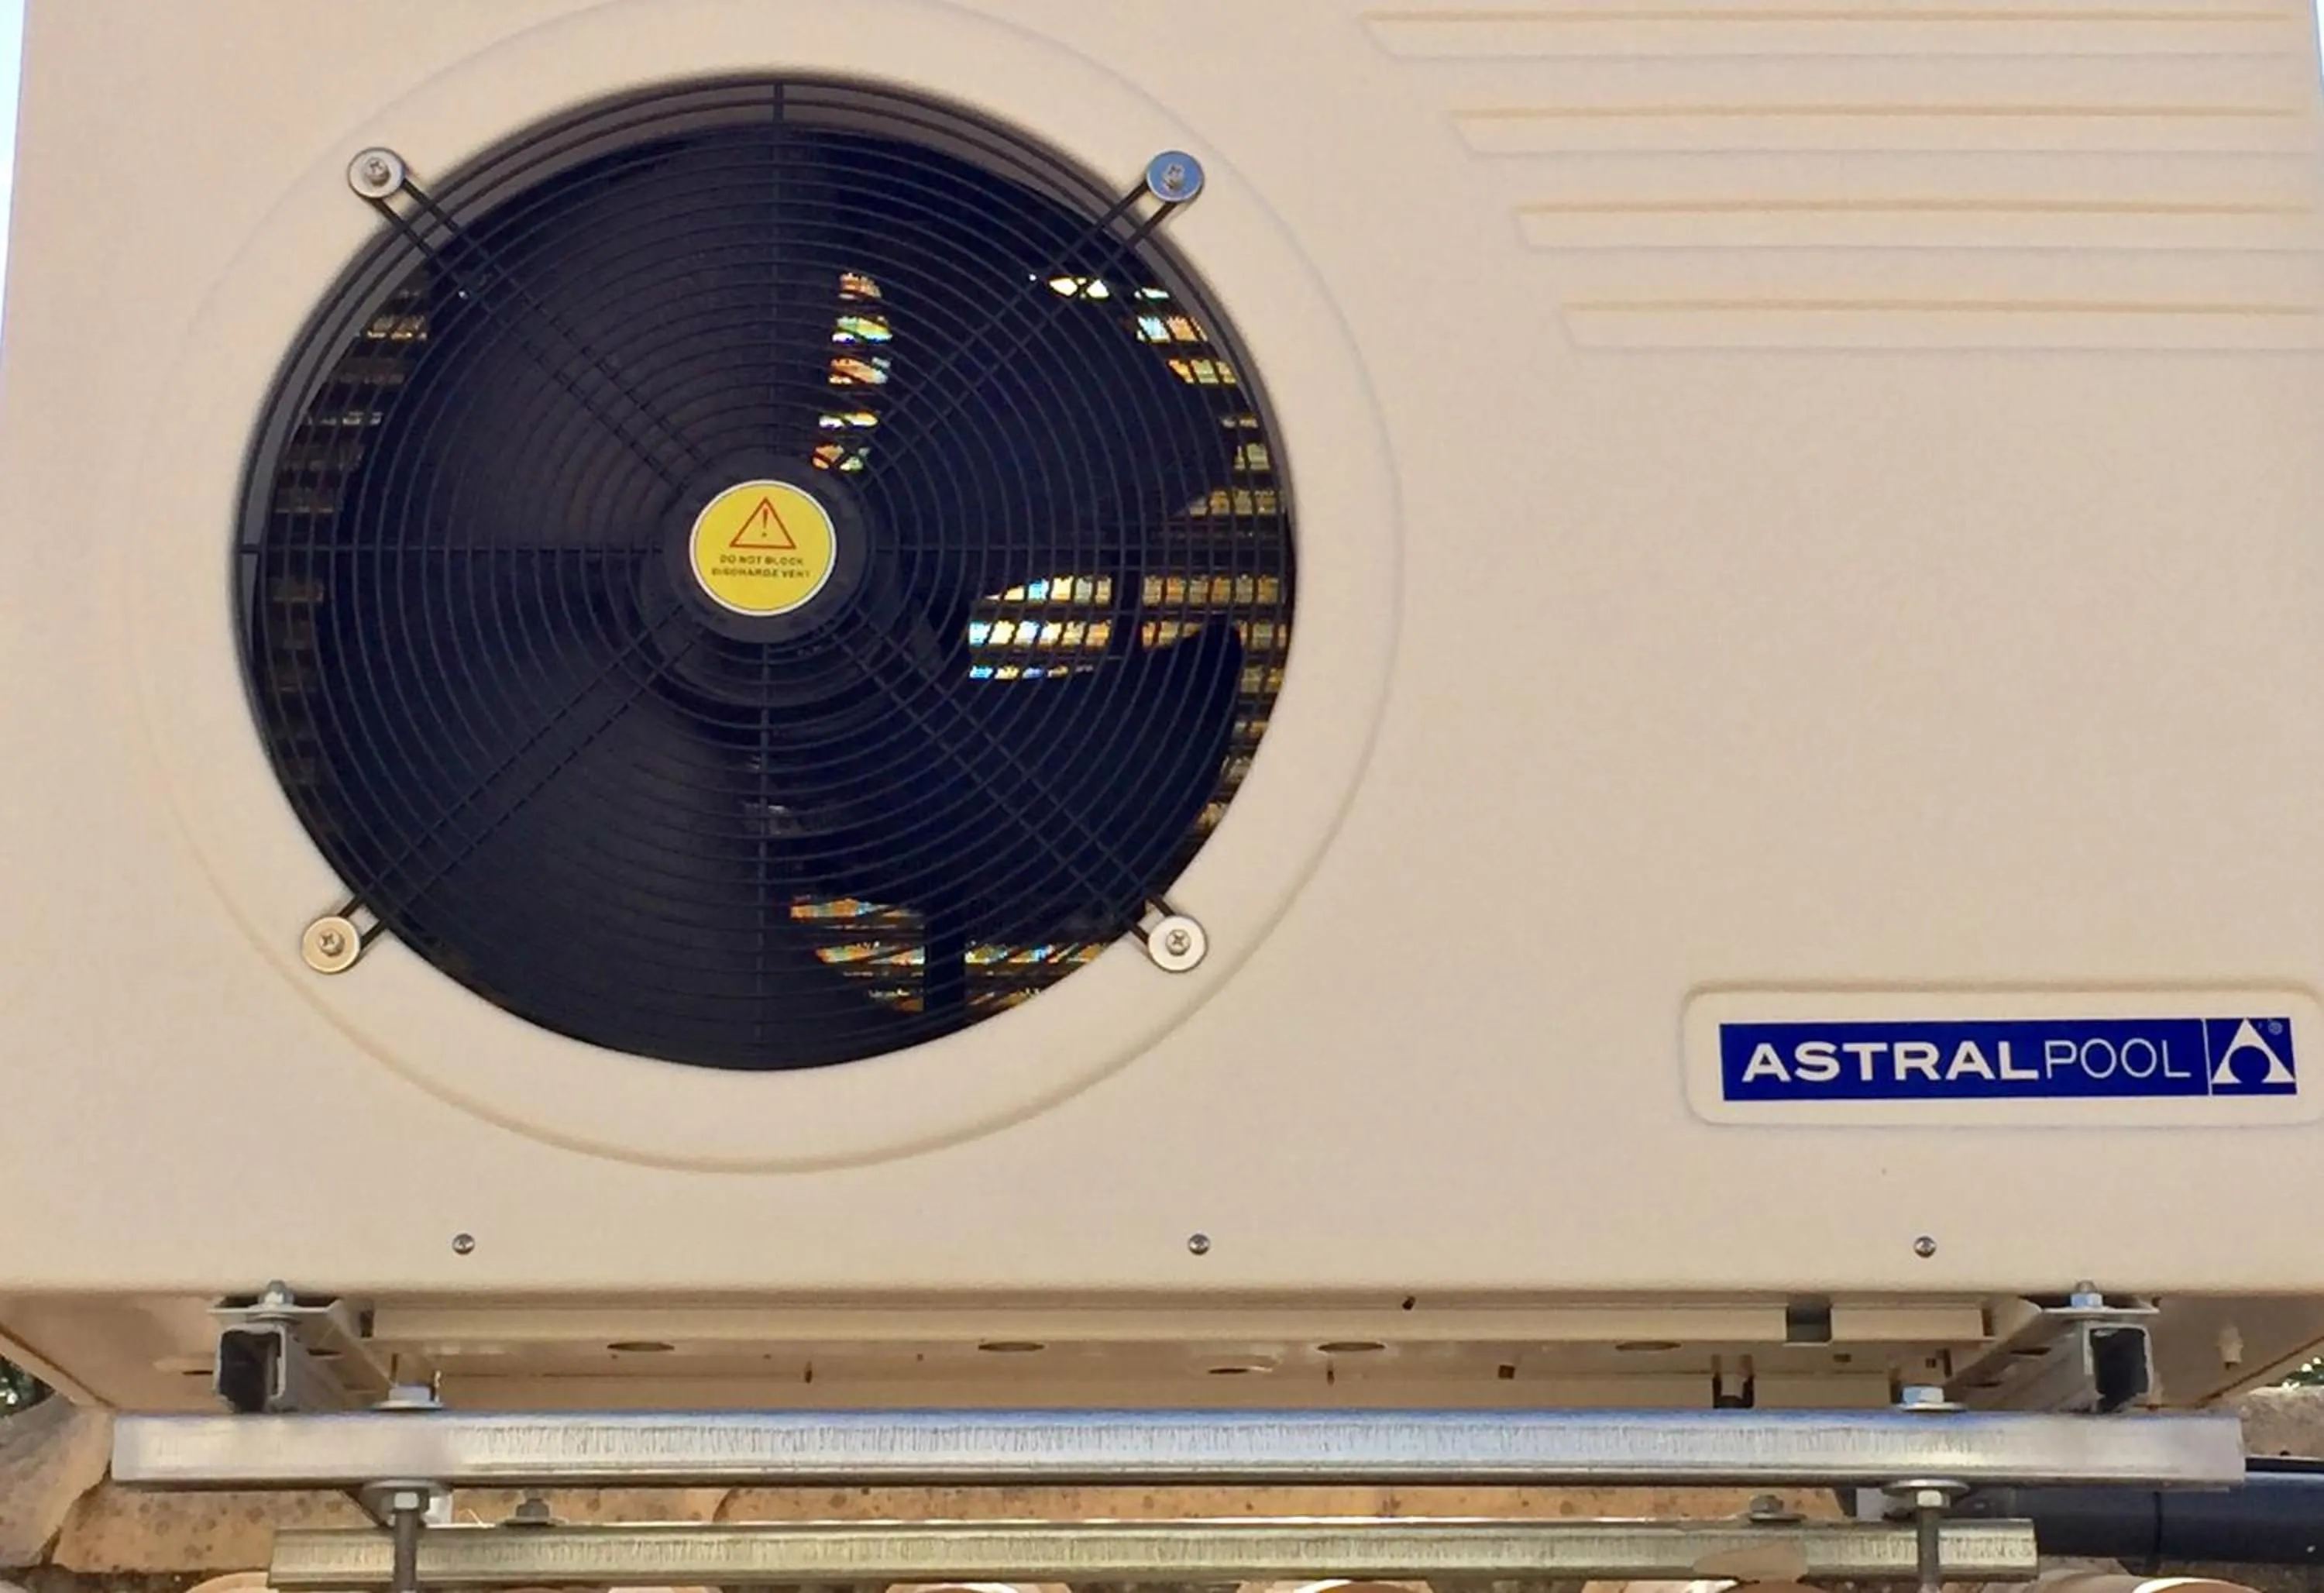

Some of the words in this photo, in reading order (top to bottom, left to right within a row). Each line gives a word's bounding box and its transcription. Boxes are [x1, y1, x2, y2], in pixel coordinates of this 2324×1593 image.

[720, 555, 737, 564] DO
[738, 556, 761, 565] NOT
[765, 556, 803, 566] BLOCK
[711, 568, 779, 577] DISCHARGE
[782, 569, 810, 578] VENT
[1741, 1038, 2192, 1082] ASTRALPOOL
